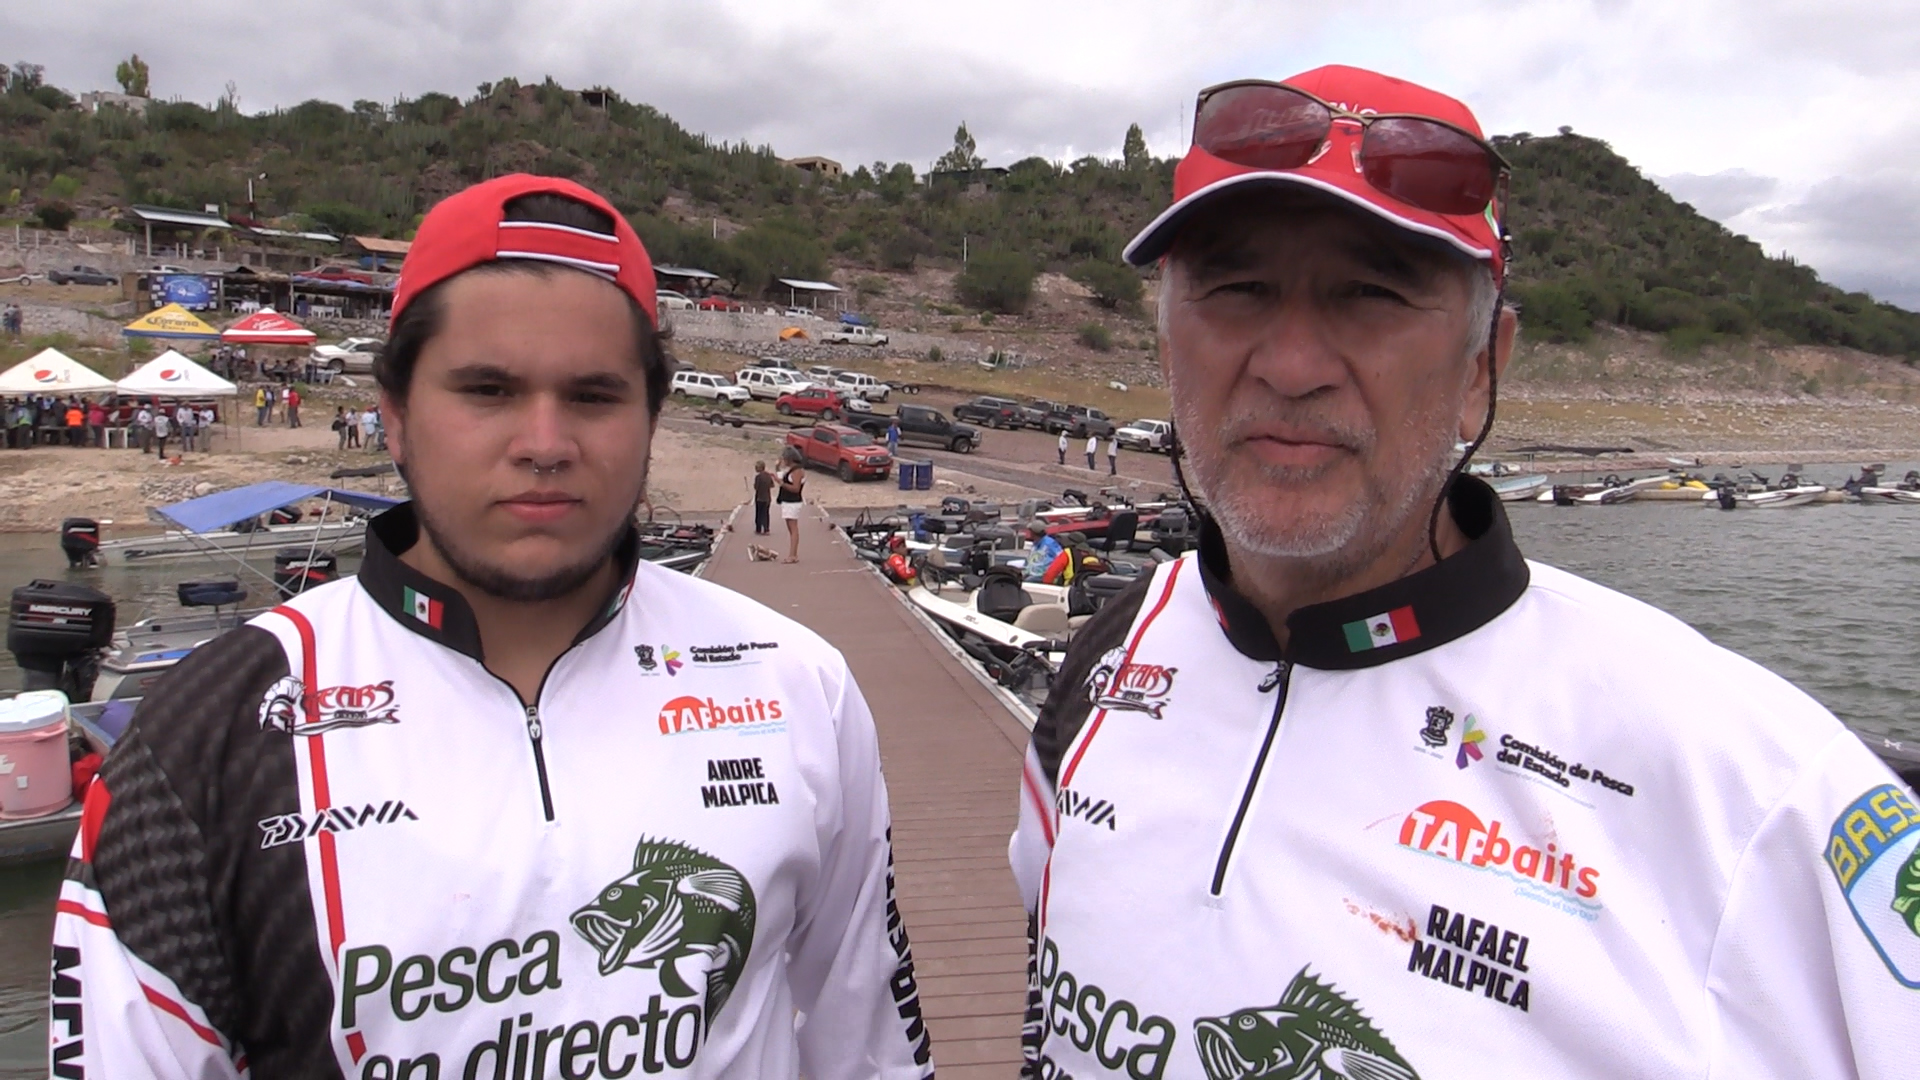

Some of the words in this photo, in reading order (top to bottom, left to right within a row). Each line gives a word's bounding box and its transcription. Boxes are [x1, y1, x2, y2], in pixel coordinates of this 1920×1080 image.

[29, 604, 93, 616] MERCURY
[692, 652, 708, 662] del
[708, 651, 742, 662] Estado
[736, 642, 749, 652] de
[750, 641, 779, 651] Pesca
[707, 757, 766, 782] ANDRE
[1496, 748, 1522, 767] del
[1522, 756, 1571, 788] Estado
[1500, 733, 1567, 773] Comisión
[1569, 762, 1590, 780] de
[1591, 769, 1635, 797] Pesca
[701, 781, 780, 809] MALPICA
[1426, 903, 1529, 973] RAFAEL
[341, 929, 562, 1030] Pesca
[1407, 938, 1529, 1012] MALPICA
[462, 993, 701, 1080] directo
